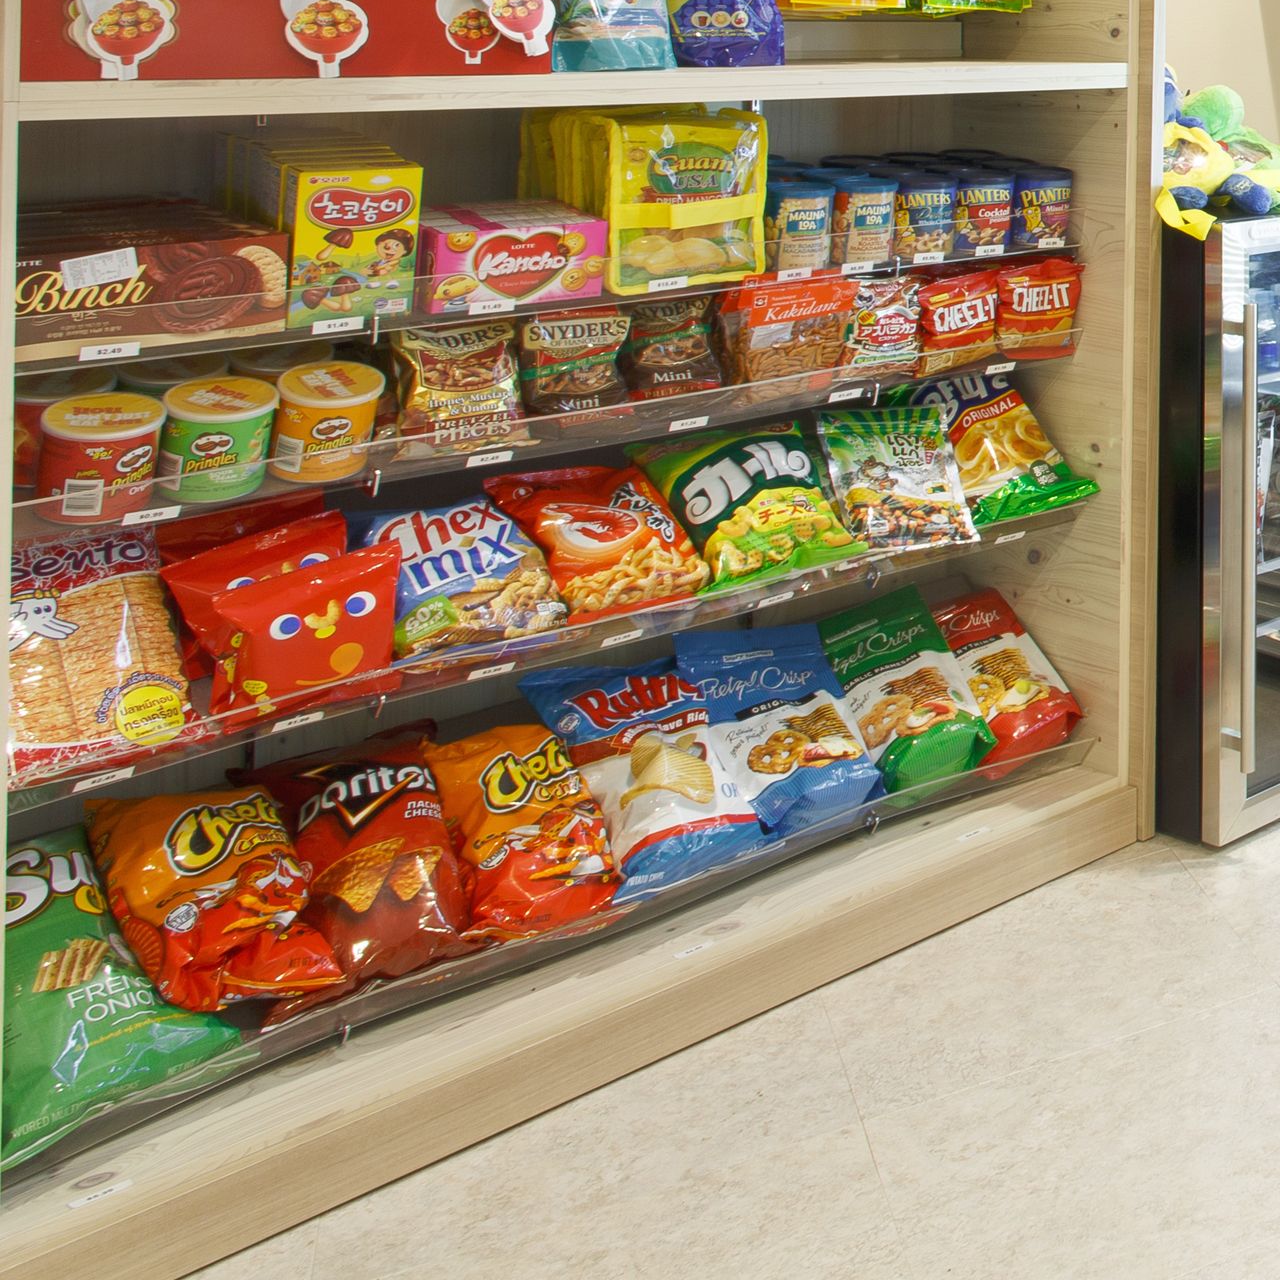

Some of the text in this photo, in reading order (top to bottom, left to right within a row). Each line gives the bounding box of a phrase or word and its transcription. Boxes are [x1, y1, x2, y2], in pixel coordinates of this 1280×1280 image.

[655, 156, 733, 173] Guam
[672, 173, 718, 190] USA
[895, 192, 952, 208] PLANTERS
[955, 188, 1010, 204] PLANTERS
[312, 193, 404, 221] 초코송이
[857, 205, 890, 217] MAUNA
[790, 210, 825, 222] MAUNA
[799, 220, 817, 230] LOA
[511, 242, 536, 251] LOTTE
[477, 252, 566, 281] Kancho
[1012, 283, 1069, 313] CHEEZ-IT
[764, 299, 841, 322] Kakidane
[528, 320, 627, 342] SNYDER'S
[97, 347, 122, 356] $2.49
[653, 370, 693, 384] Mini
[963, 397, 1016, 429] ORIGINAL
[435, 422, 512, 445] PIECES
[305, 434, 353, 459] Pringles
[185, 452, 237, 474] Pringles
[139, 510, 165, 521] $0.99
